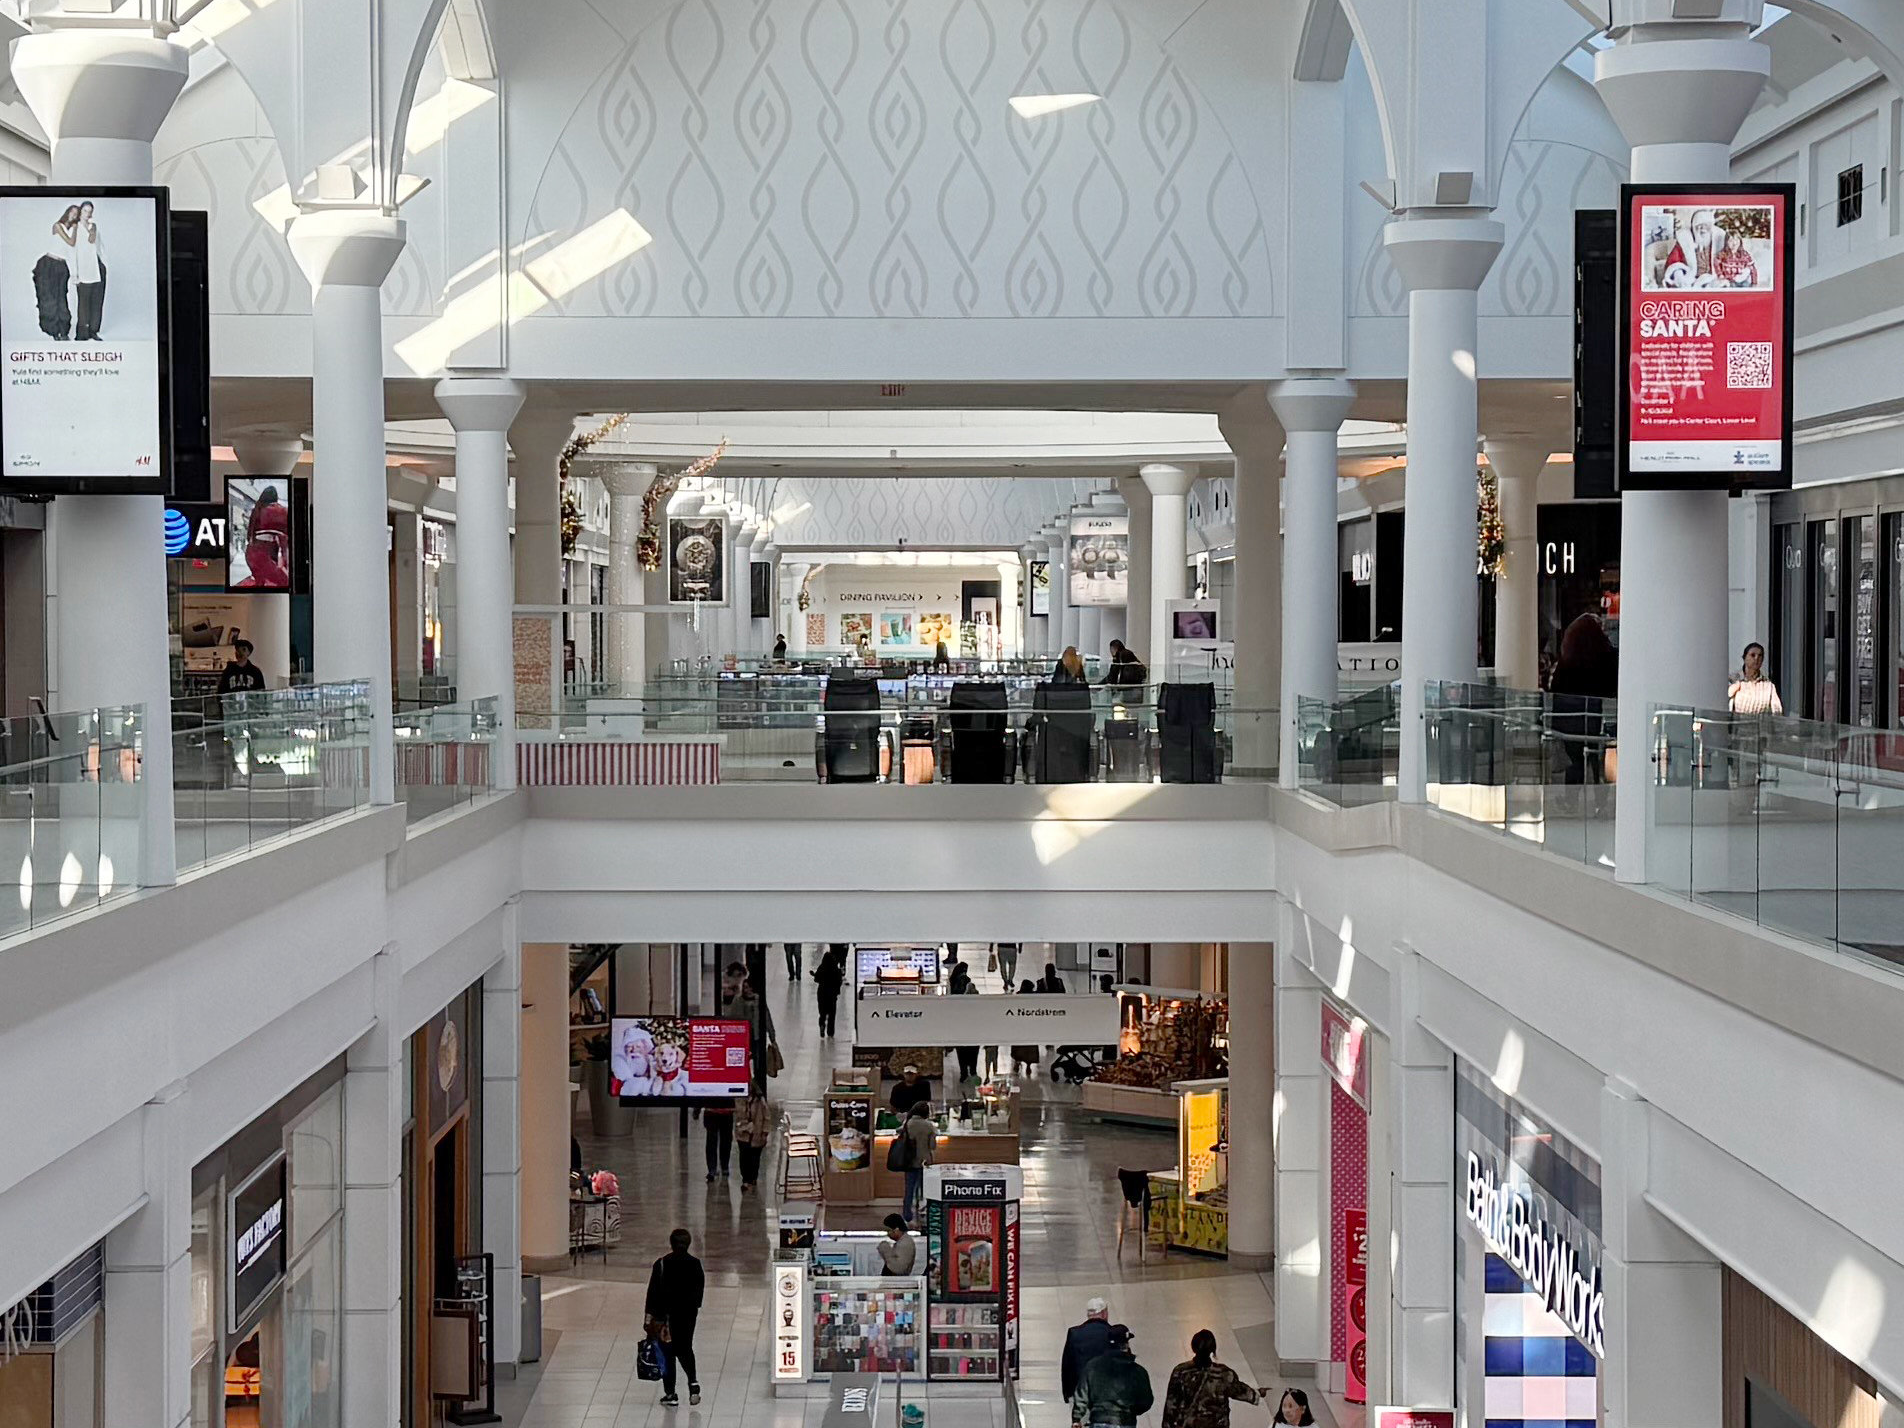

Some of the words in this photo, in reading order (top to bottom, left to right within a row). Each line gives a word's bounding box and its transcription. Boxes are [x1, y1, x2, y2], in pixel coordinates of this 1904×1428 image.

[1640, 301, 1725, 319] CARING
[1640, 319, 1712, 337] SANTA
[10, 352, 44, 362] GIFTS
[47, 352, 78, 362] THAT
[81, 352, 123, 362] SLEIGH
[840, 592, 872, 601] DINING
[885, 1009, 924, 1018] Elevator
[1017, 1008, 1067, 1017] Nordstrom
[944, 1184, 982, 1196] Phone
[983, 1184, 1003, 1196] Fix
[954, 1209, 993, 1226] DEVICE
[1466, 1149, 1499, 1240] Bath
[1511, 1191, 1560, 1313] Body
[1553, 1232, 1605, 1359] Works
[1007, 1252, 1015, 1279] CAN
[781, 1351, 796, 1366] 15
